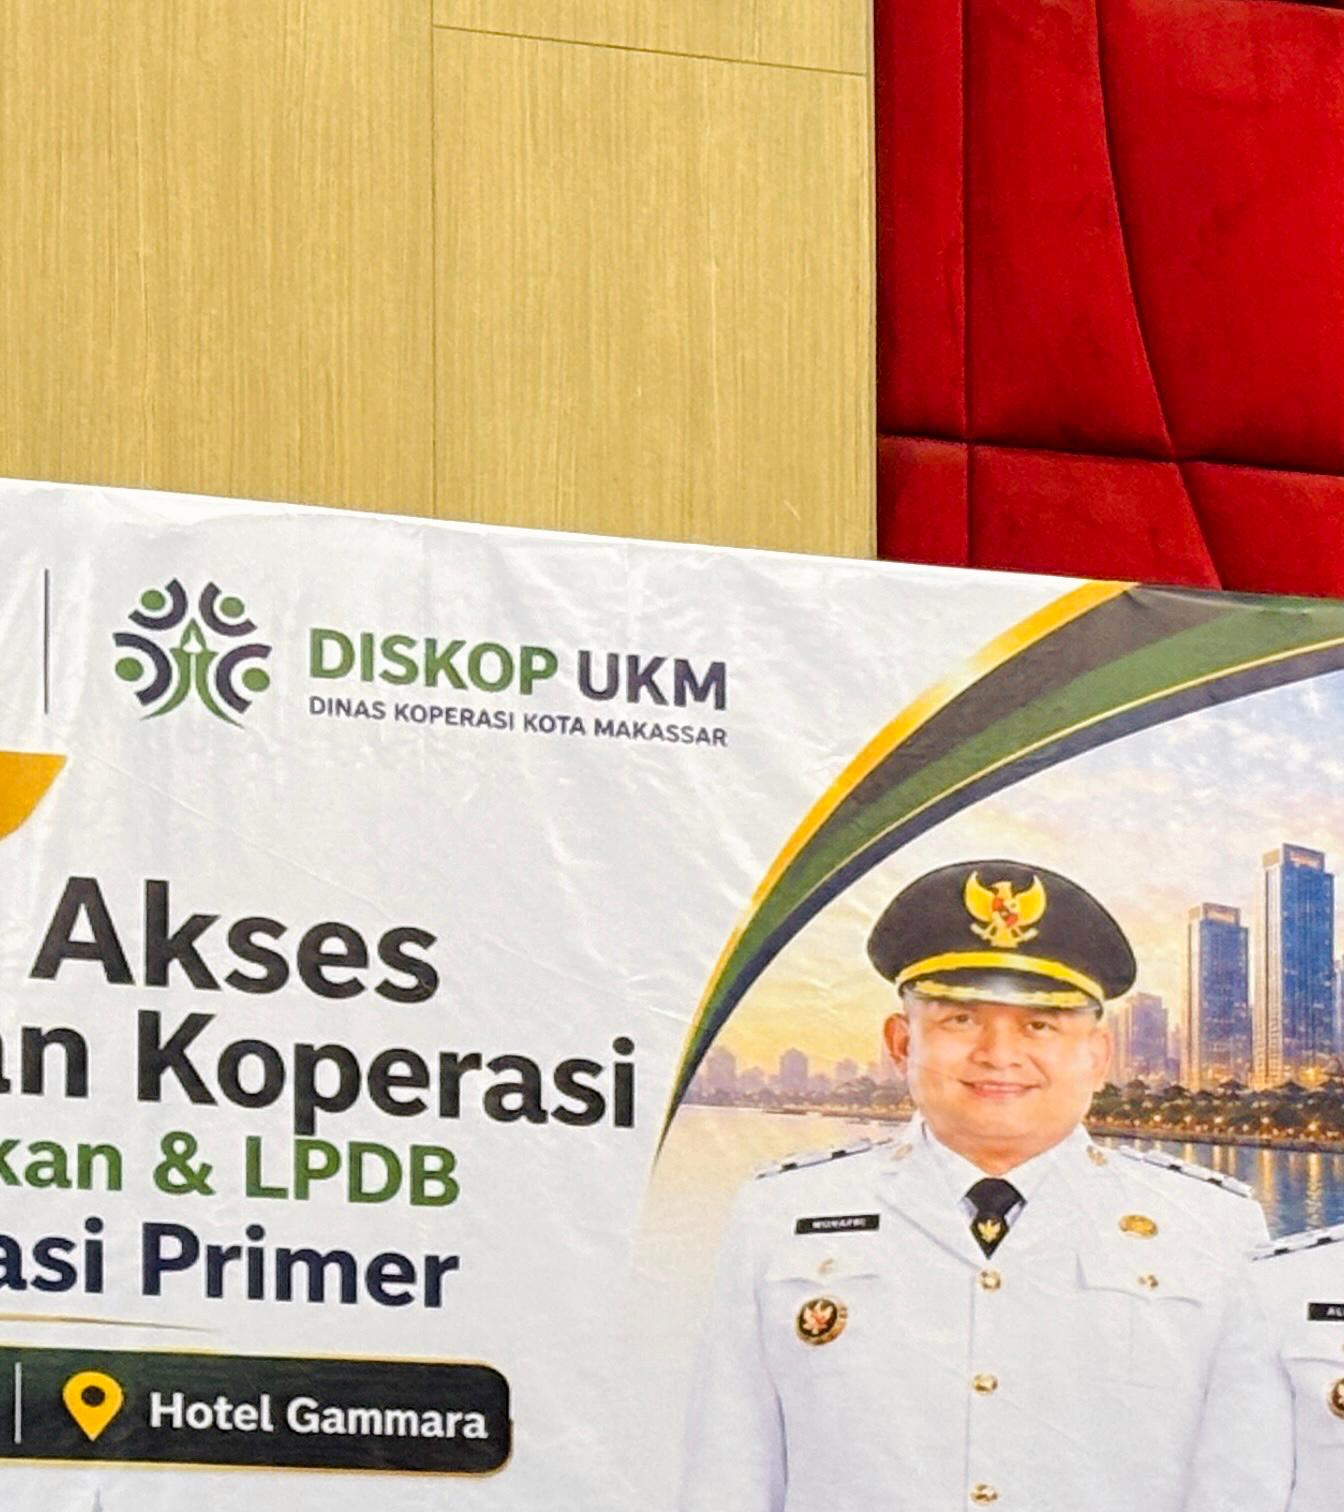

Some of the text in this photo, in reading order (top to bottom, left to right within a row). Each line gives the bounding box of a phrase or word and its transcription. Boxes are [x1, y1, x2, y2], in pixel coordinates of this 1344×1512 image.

[309, 627, 728, 712] DISKOP UKM
[309, 695, 728, 748] DINAS KOPERASI KOTA MAKASSAR
[29, 876, 440, 1004] Akses
[136, 1009, 637, 1137] Koperasi
[152, 1130, 216, 1196] &
[245, 1135, 461, 1207] LPDB
[142, 1222, 460, 1308] Primer
[151, 1391, 489, 1440] Hotel Gammara
